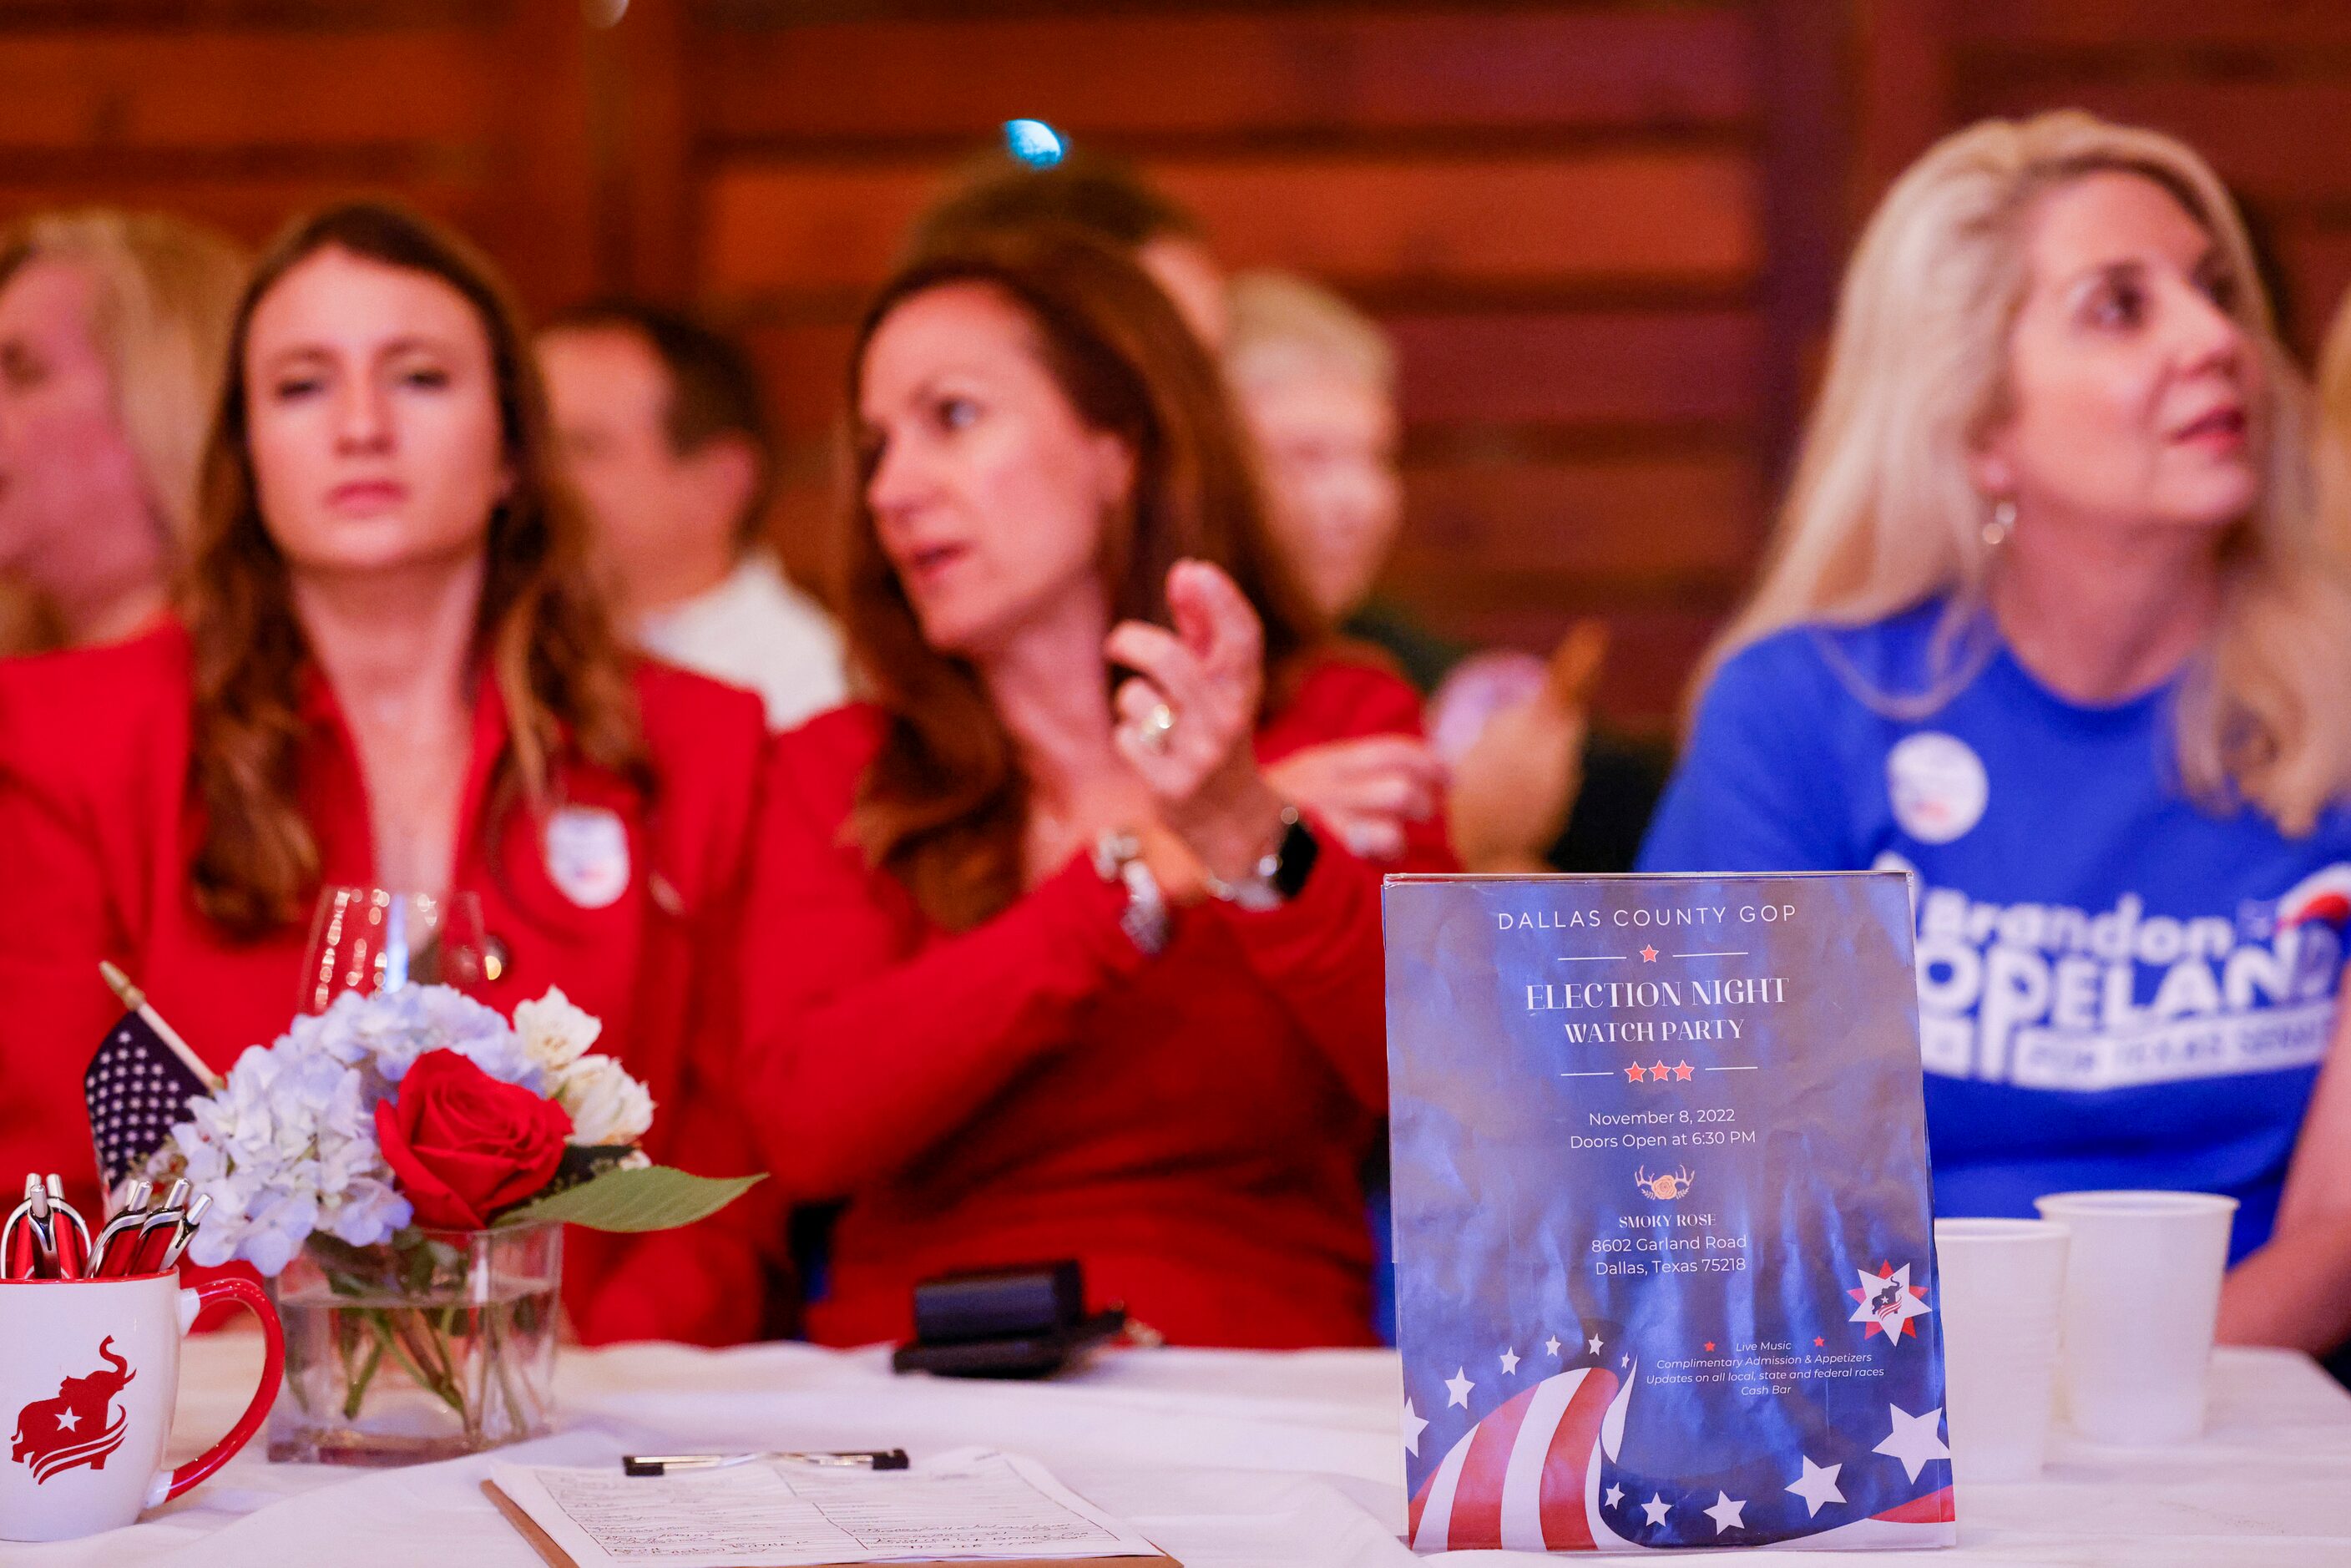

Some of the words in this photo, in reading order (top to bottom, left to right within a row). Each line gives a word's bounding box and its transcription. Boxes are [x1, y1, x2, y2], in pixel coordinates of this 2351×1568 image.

[1498, 909, 1600, 930] DALLAS
[1613, 906, 1727, 927] COUNTY
[1739, 904, 1796, 923] GOP
[1921, 887, 2236, 963] Brandon
[1525, 981, 1681, 1011] ELECTION
[1691, 978, 1790, 1006] NIGHT
[1915, 925, 2336, 1079] OPELAN
[1564, 1022, 1655, 1044] WATCH
[1661, 1019, 1744, 1041] PARTY
[1589, 1110, 1675, 1125] November
[1679, 1110, 1693, 1125] 8,
[1696, 1108, 1736, 1123] 2022
[1570, 1136, 1619, 1149] Doors
[1622, 1134, 1668, 1150] Open
[1671, 1133, 1688, 1146] at
[1691, 1130, 1726, 1146] 6:30
[1730, 1130, 1756, 1144] PM
[1619, 1214, 1672, 1229] SMOKY
[1676, 1213, 1716, 1227] ROSE
[1591, 1238, 1632, 1252] 8602
[1636, 1235, 1701, 1252] Garland
[1705, 1234, 1747, 1250] Road
[1595, 1260, 1648, 1277] Dallas,
[1651, 1260, 1698, 1274] Texas
[1701, 1257, 1747, 1272] 75218
[1735, 1342, 1758, 1353] Live
[1760, 1341, 1792, 1351] Music
[1656, 1358, 1743, 1370] Complimentary
[1744, 1356, 1802, 1367] Admission
[1804, 1354, 1813, 1364] &
[1814, 1353, 1873, 1364] Appetizers
[1646, 1373, 1693, 1386] Updates
[1695, 1374, 1710, 1383] on
[1711, 1372, 1726, 1382] all
[1727, 1370, 1757, 1382] local,
[1758, 1371, 1787, 1380] state
[1788, 1368, 1812, 1379] and
[1813, 1368, 1853, 1378] federal
[1854, 1368, 1884, 1377] races
[1741, 1385, 1769, 1396] Cash
[1772, 1384, 1792, 1394] Bar
